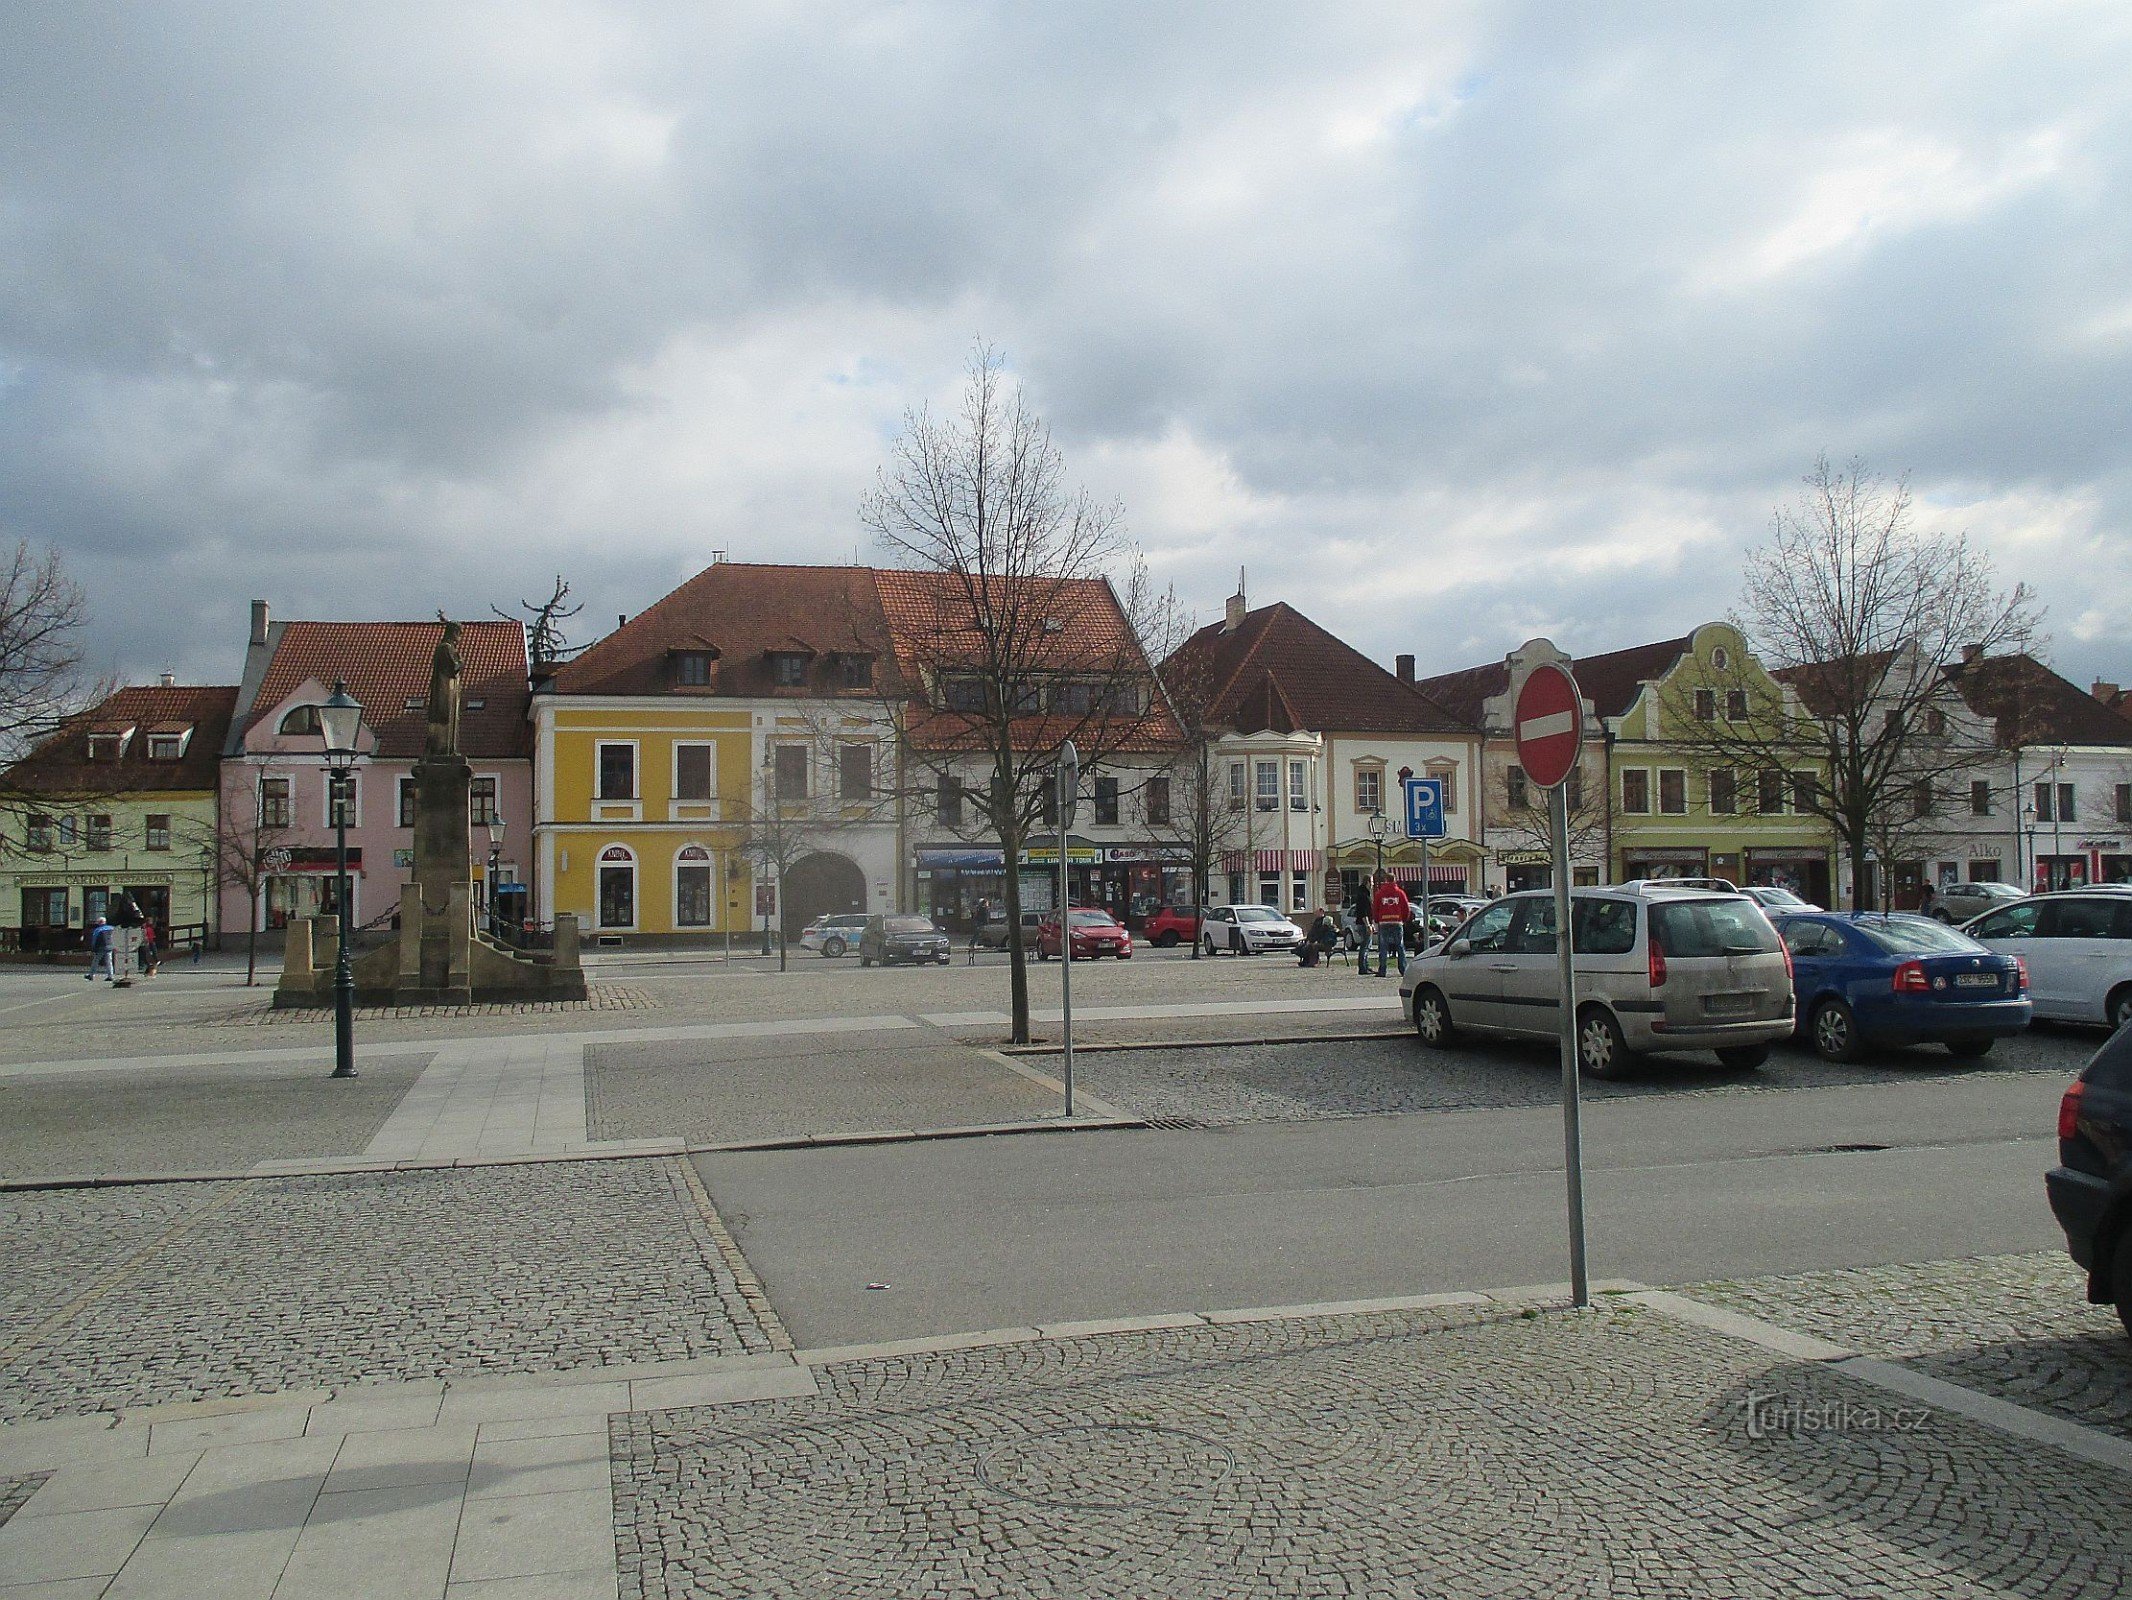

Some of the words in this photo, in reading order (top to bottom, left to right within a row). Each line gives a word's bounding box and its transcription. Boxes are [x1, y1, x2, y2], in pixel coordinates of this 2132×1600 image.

[1413, 786, 1435, 820] P
[1414, 822, 1427, 832] 3x
[1968, 844, 2001, 857] Alko
